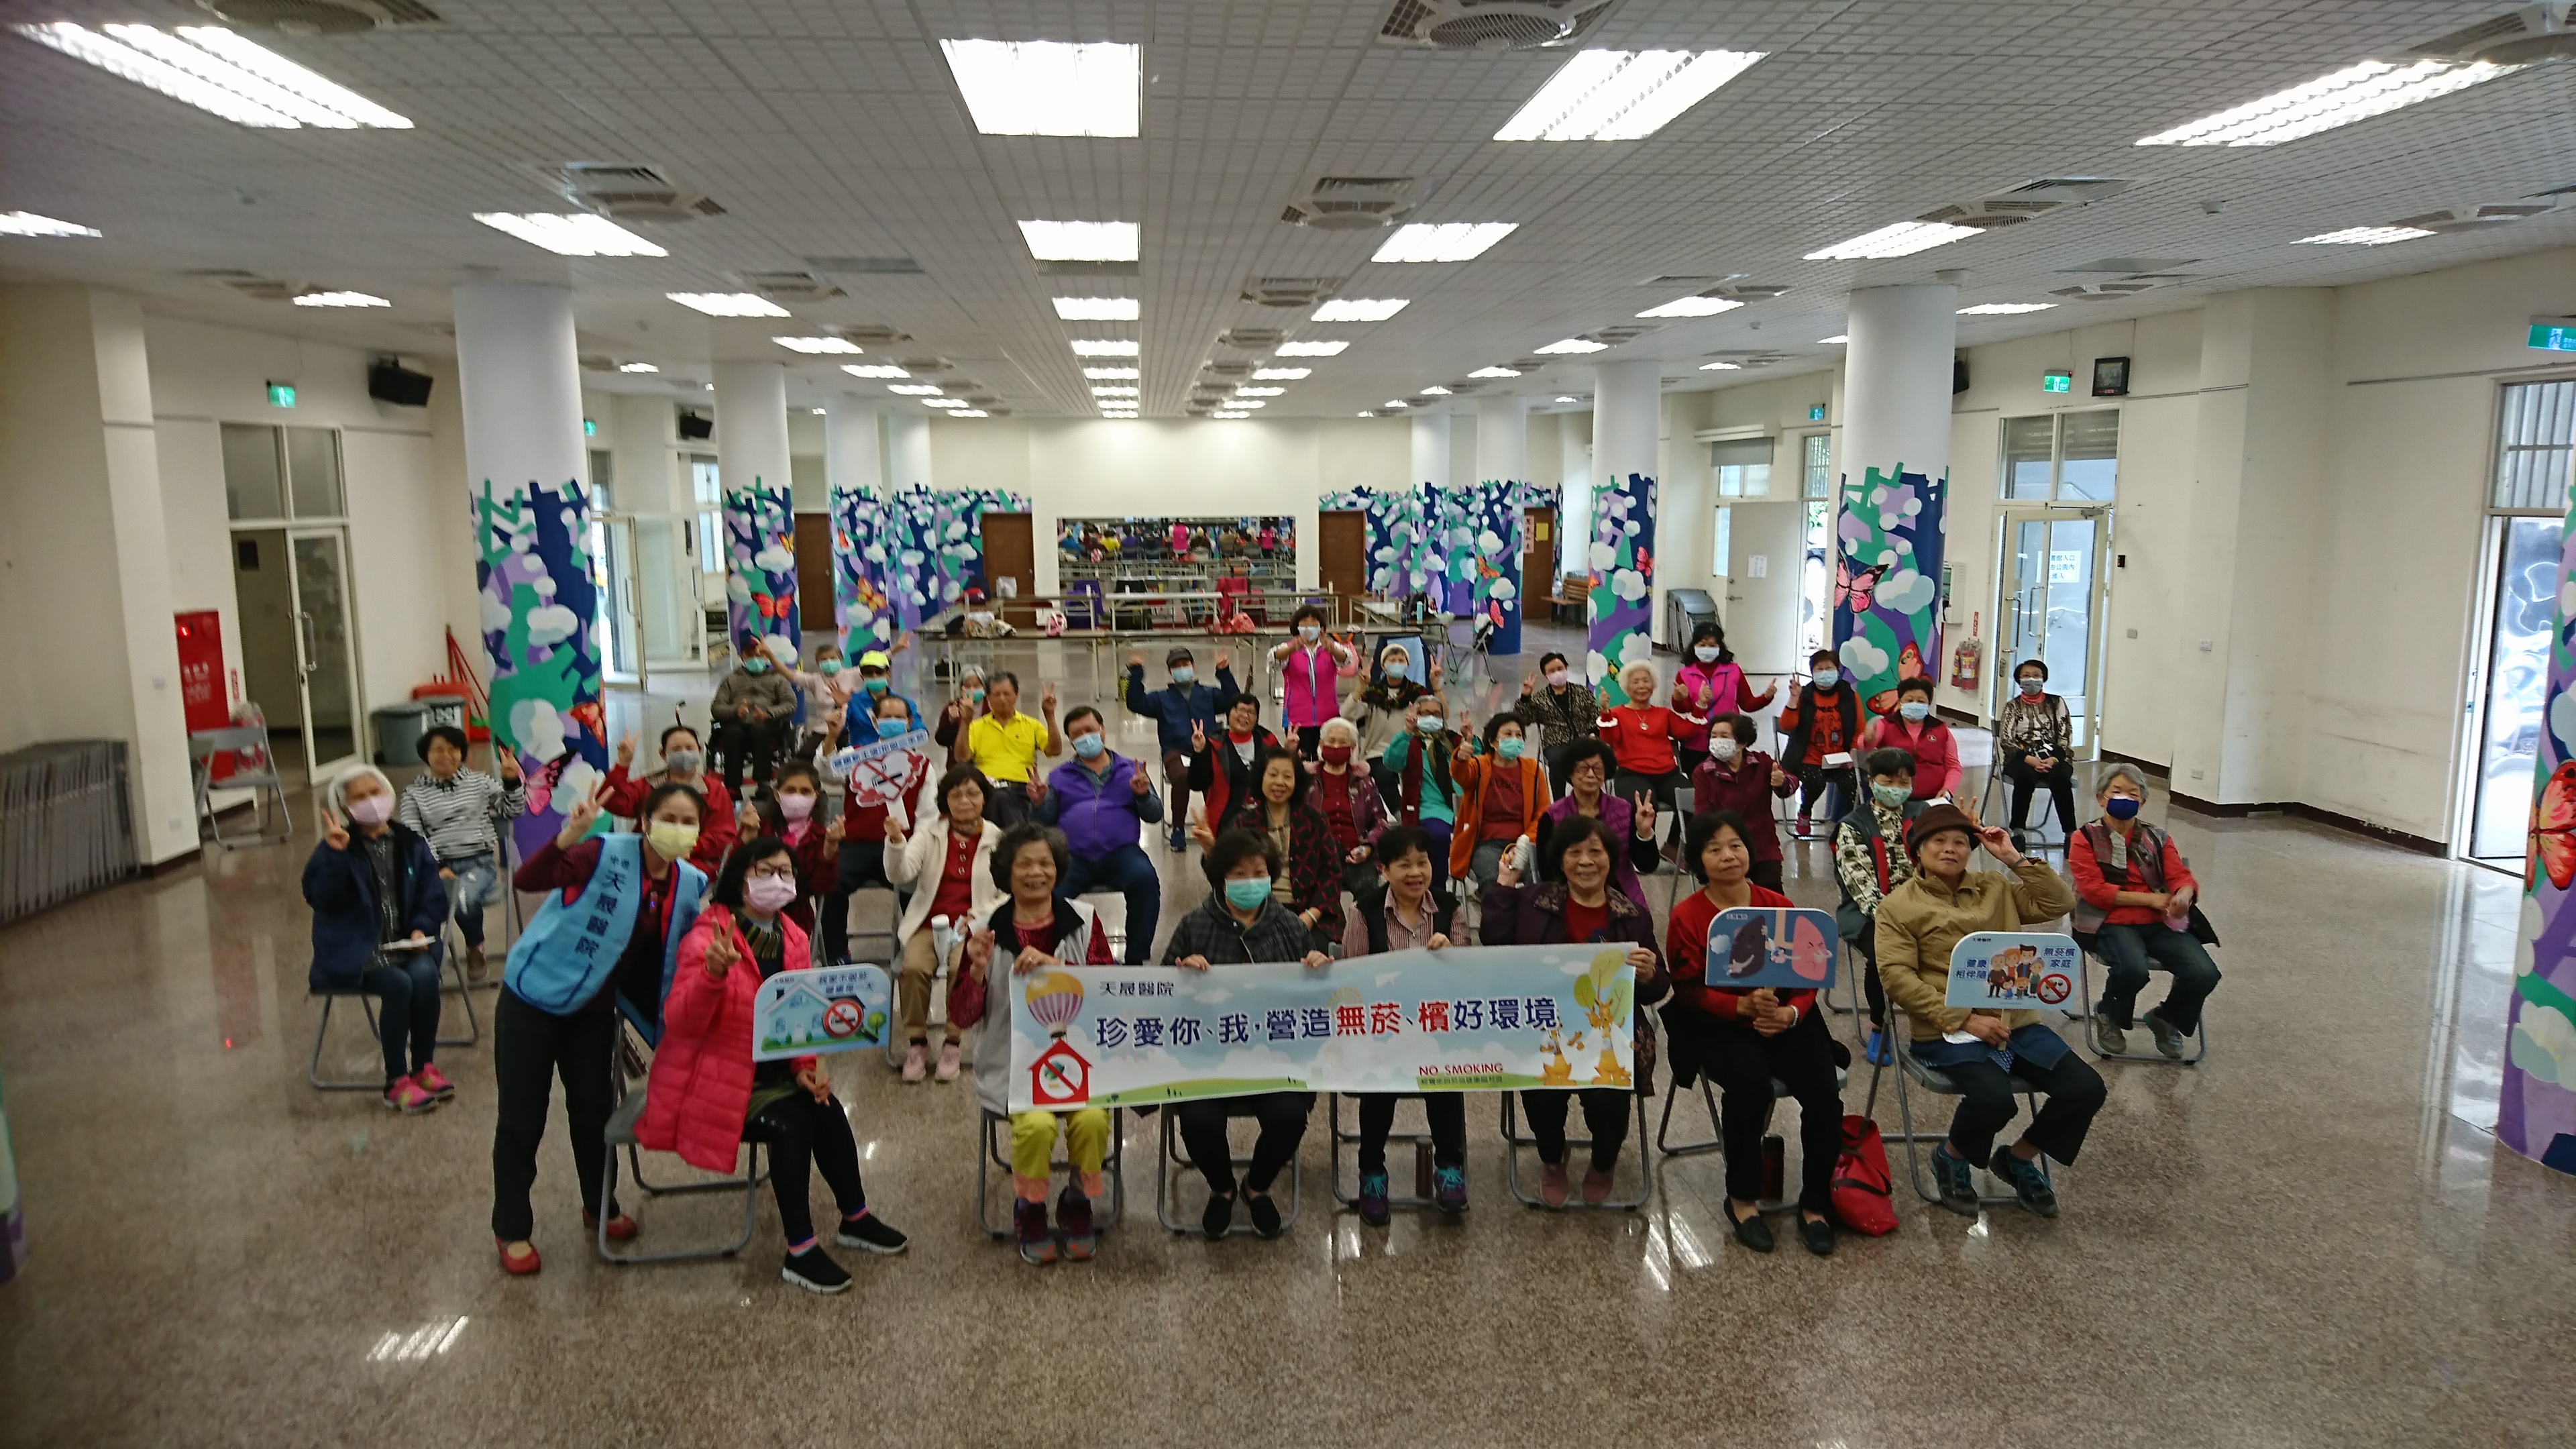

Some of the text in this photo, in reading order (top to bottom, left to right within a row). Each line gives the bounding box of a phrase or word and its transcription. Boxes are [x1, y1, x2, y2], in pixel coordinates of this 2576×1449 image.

[2050, 959, 2072, 968] 家庭
[1099, 981, 1174, 997] 天晟醫院
[1419, 1062, 1503, 1077] NO SMOKING
